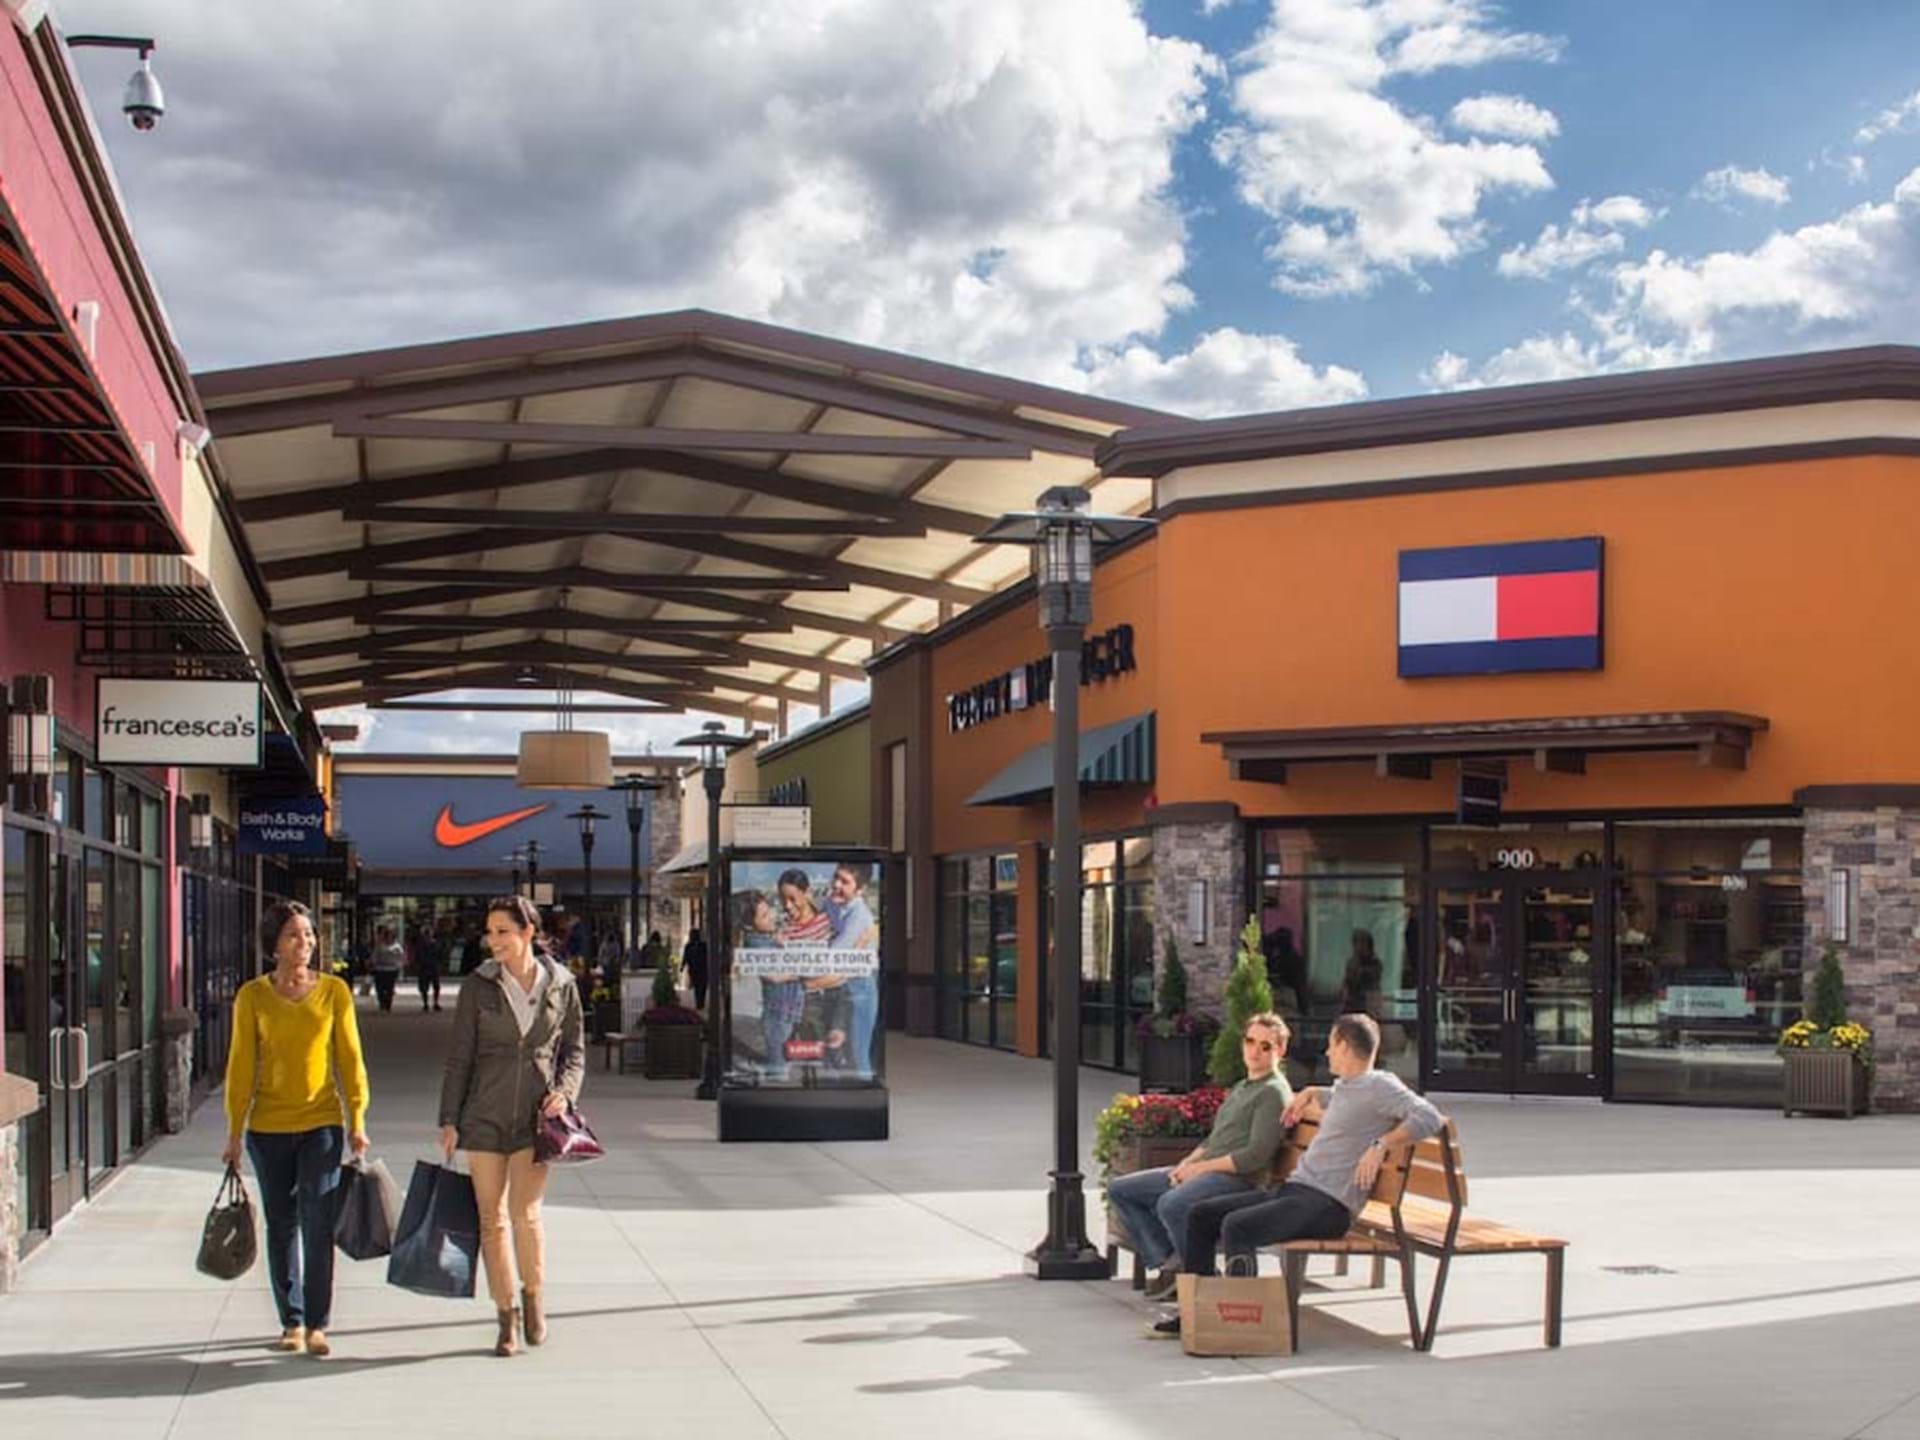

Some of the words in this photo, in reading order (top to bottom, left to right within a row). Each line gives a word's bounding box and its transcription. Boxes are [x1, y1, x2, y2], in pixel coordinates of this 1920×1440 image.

[946, 672, 1011, 735] TOMMY
[102, 706, 256, 738] francesca's
[241, 811, 274, 826] Bath
[275, 811, 286, 825] &
[287, 812, 323, 829] Body
[261, 827, 305, 841] Works
[1498, 849, 1534, 869] 900
[783, 953, 830, 964] OUTLET
[833, 953, 873, 964] STORE
